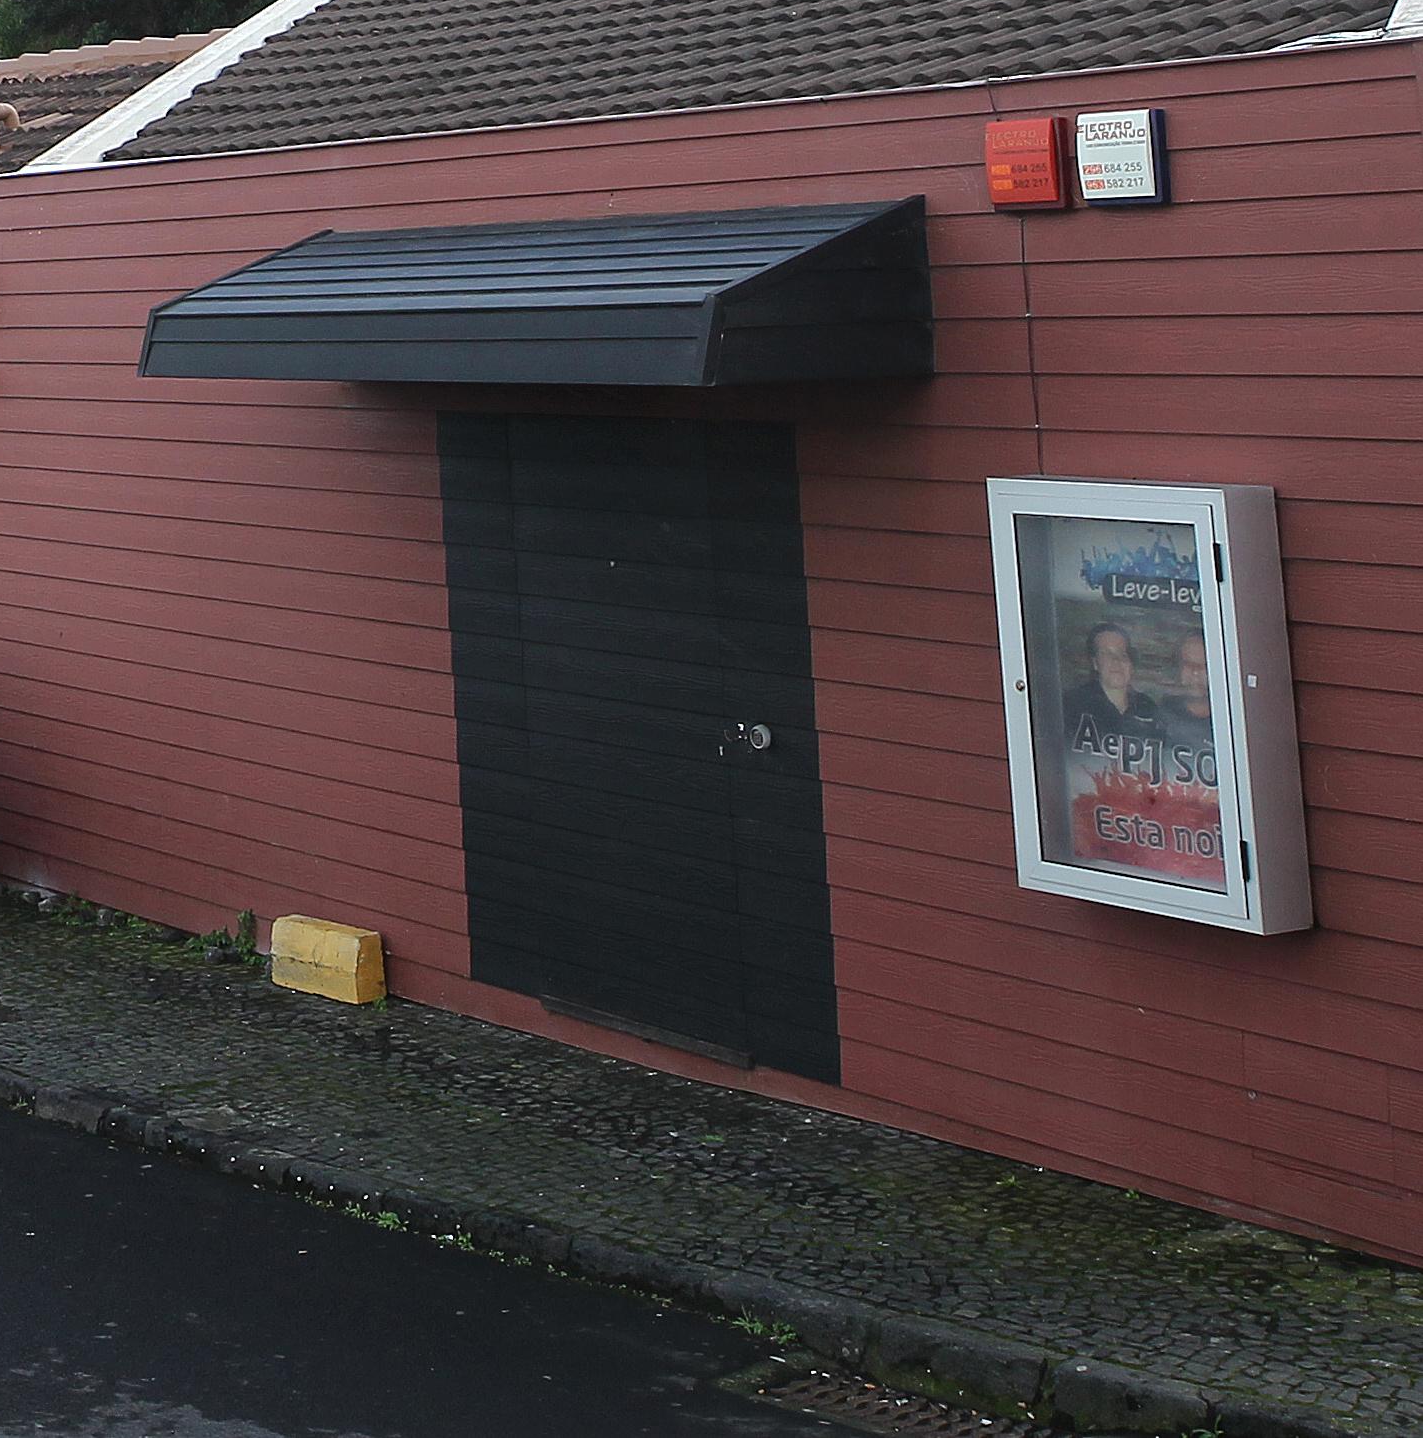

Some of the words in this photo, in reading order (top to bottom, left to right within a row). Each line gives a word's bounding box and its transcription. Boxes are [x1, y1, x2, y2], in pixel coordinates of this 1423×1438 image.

[1085, 125, 1146, 141] LARANJO
[1104, 164, 1122, 173] 684
[1124, 162, 1143, 172] 255
[1106, 178, 1125, 188] 582
[1127, 177, 1144, 187] 217
[1094, 805, 1165, 850] Esta
